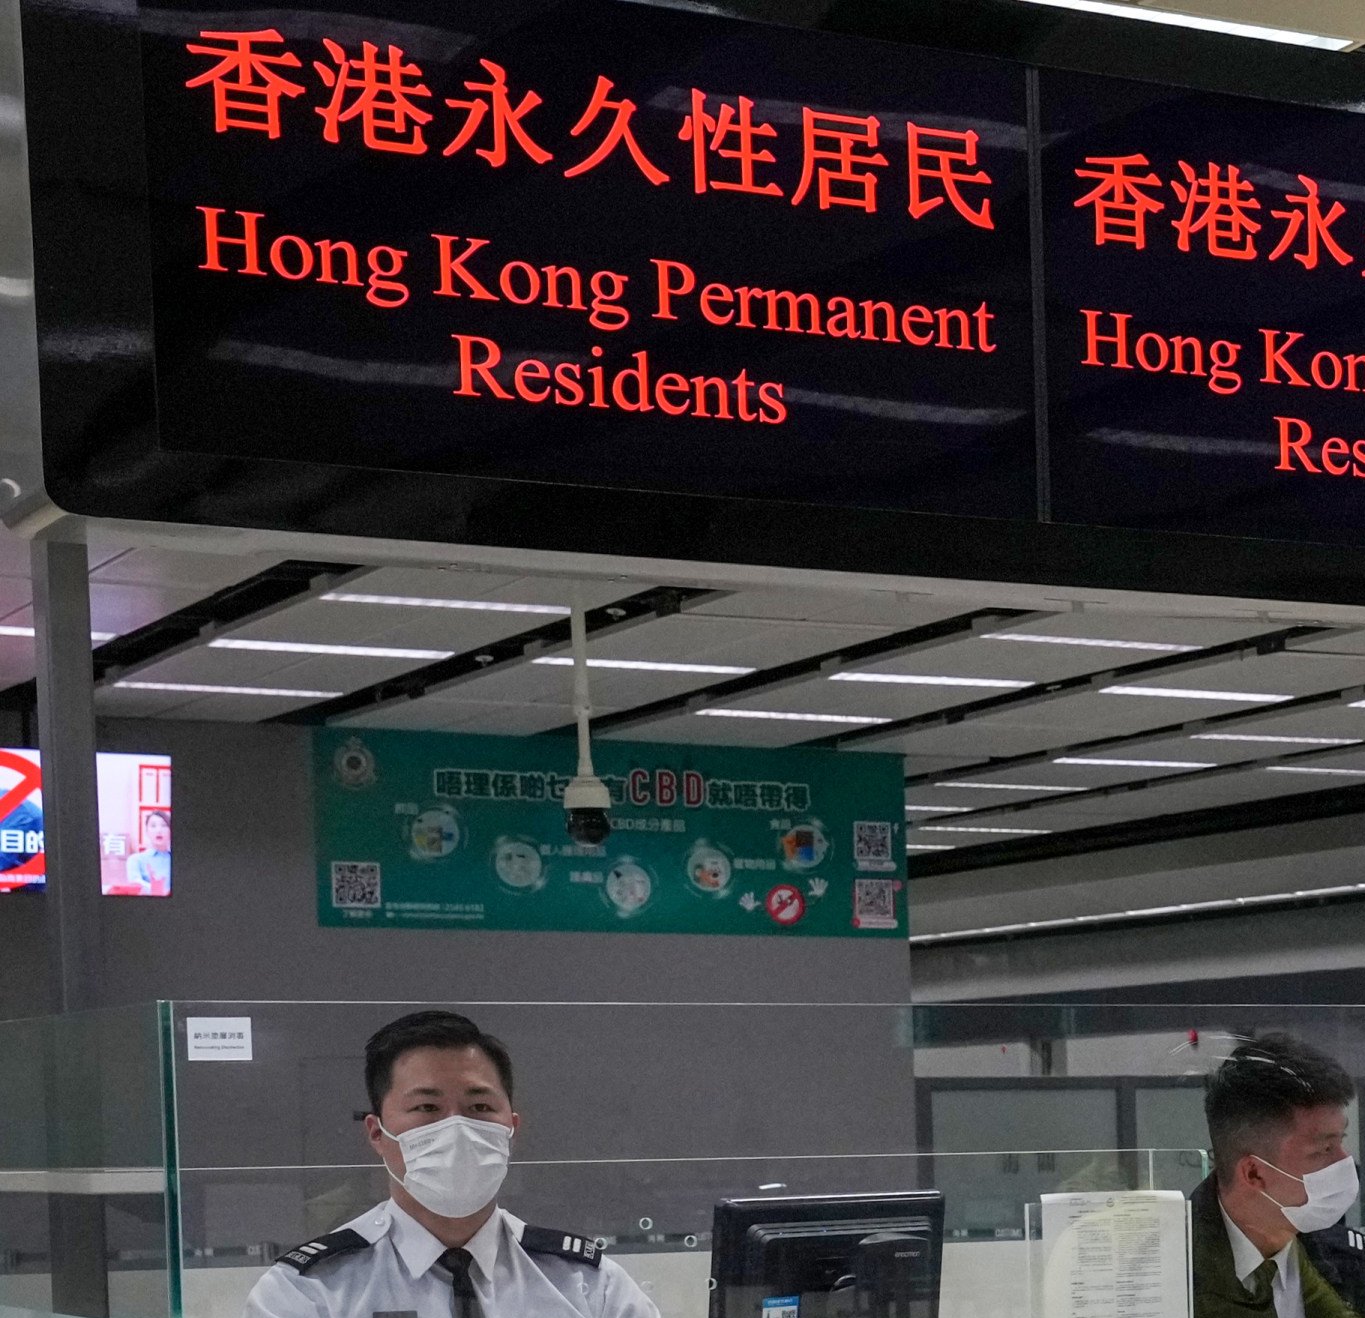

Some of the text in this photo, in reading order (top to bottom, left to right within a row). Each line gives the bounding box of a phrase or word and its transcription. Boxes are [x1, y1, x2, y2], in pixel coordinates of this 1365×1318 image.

[185, 28, 996, 230] 香港永久性居民
[196, 205, 997, 353] Hong Kong Permanent
[450, 334, 788, 426] Residents
[1079, 309, 1243, 395] Hong
